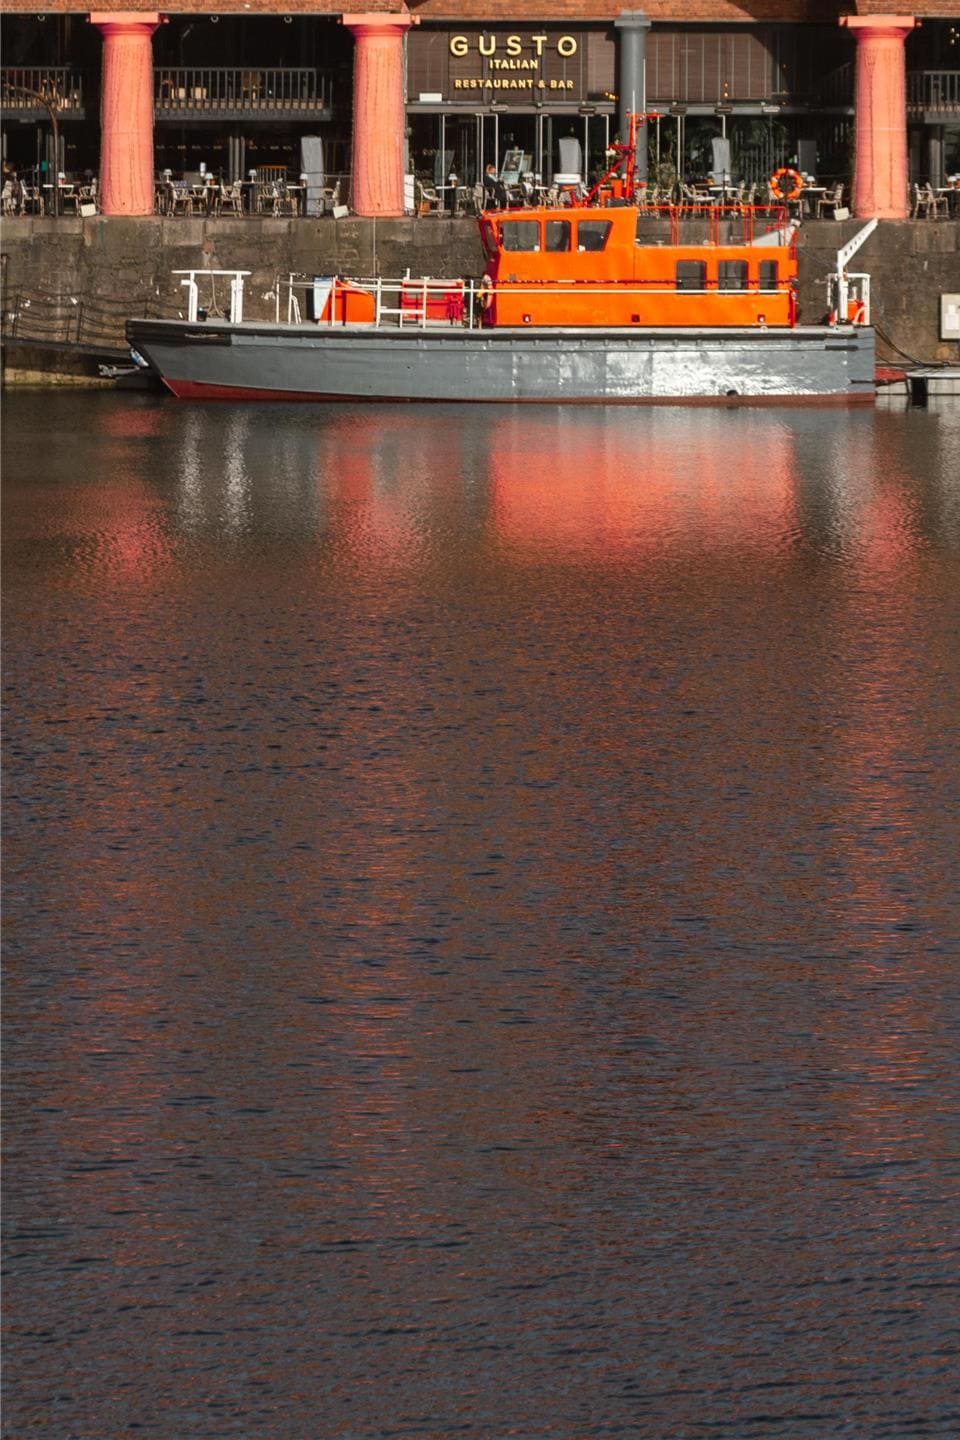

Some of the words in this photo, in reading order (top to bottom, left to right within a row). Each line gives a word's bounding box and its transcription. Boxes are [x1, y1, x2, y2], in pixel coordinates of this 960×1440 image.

[450, 35, 577, 56] GUSTO
[489, 59, 538, 69] ITALIAN
[455, 79, 533, 89] RESTAURANT
[538, 79, 545, 89] &
[550, 79, 574, 89] BAR
